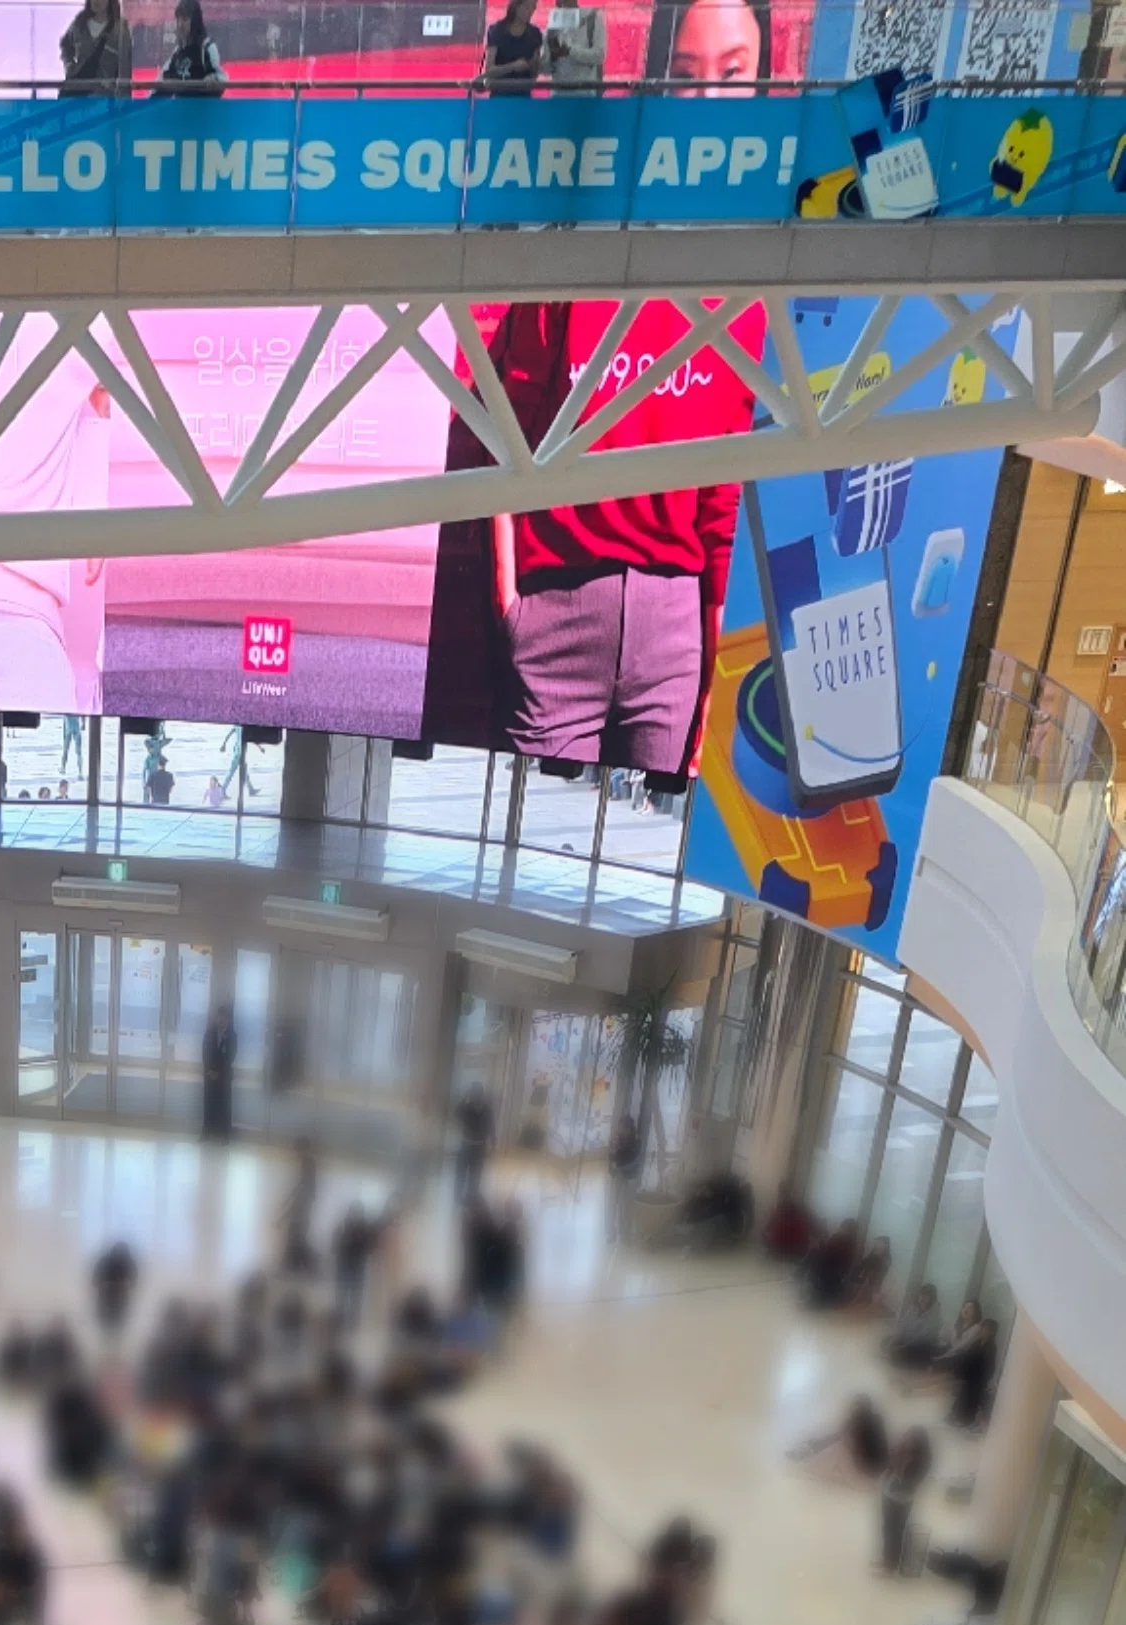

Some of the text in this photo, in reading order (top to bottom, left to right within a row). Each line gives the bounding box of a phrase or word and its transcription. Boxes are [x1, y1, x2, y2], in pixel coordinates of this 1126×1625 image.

[133, 140, 335, 191] TIMES
[361, 138, 618, 192] SQUARE
[639, 136, 796, 188] APP!
[250, 622, 283, 645] UNI
[808, 606, 882, 655] TIMES
[248, 645, 285, 669] QLO
[813, 645, 886, 692] SQUARE
